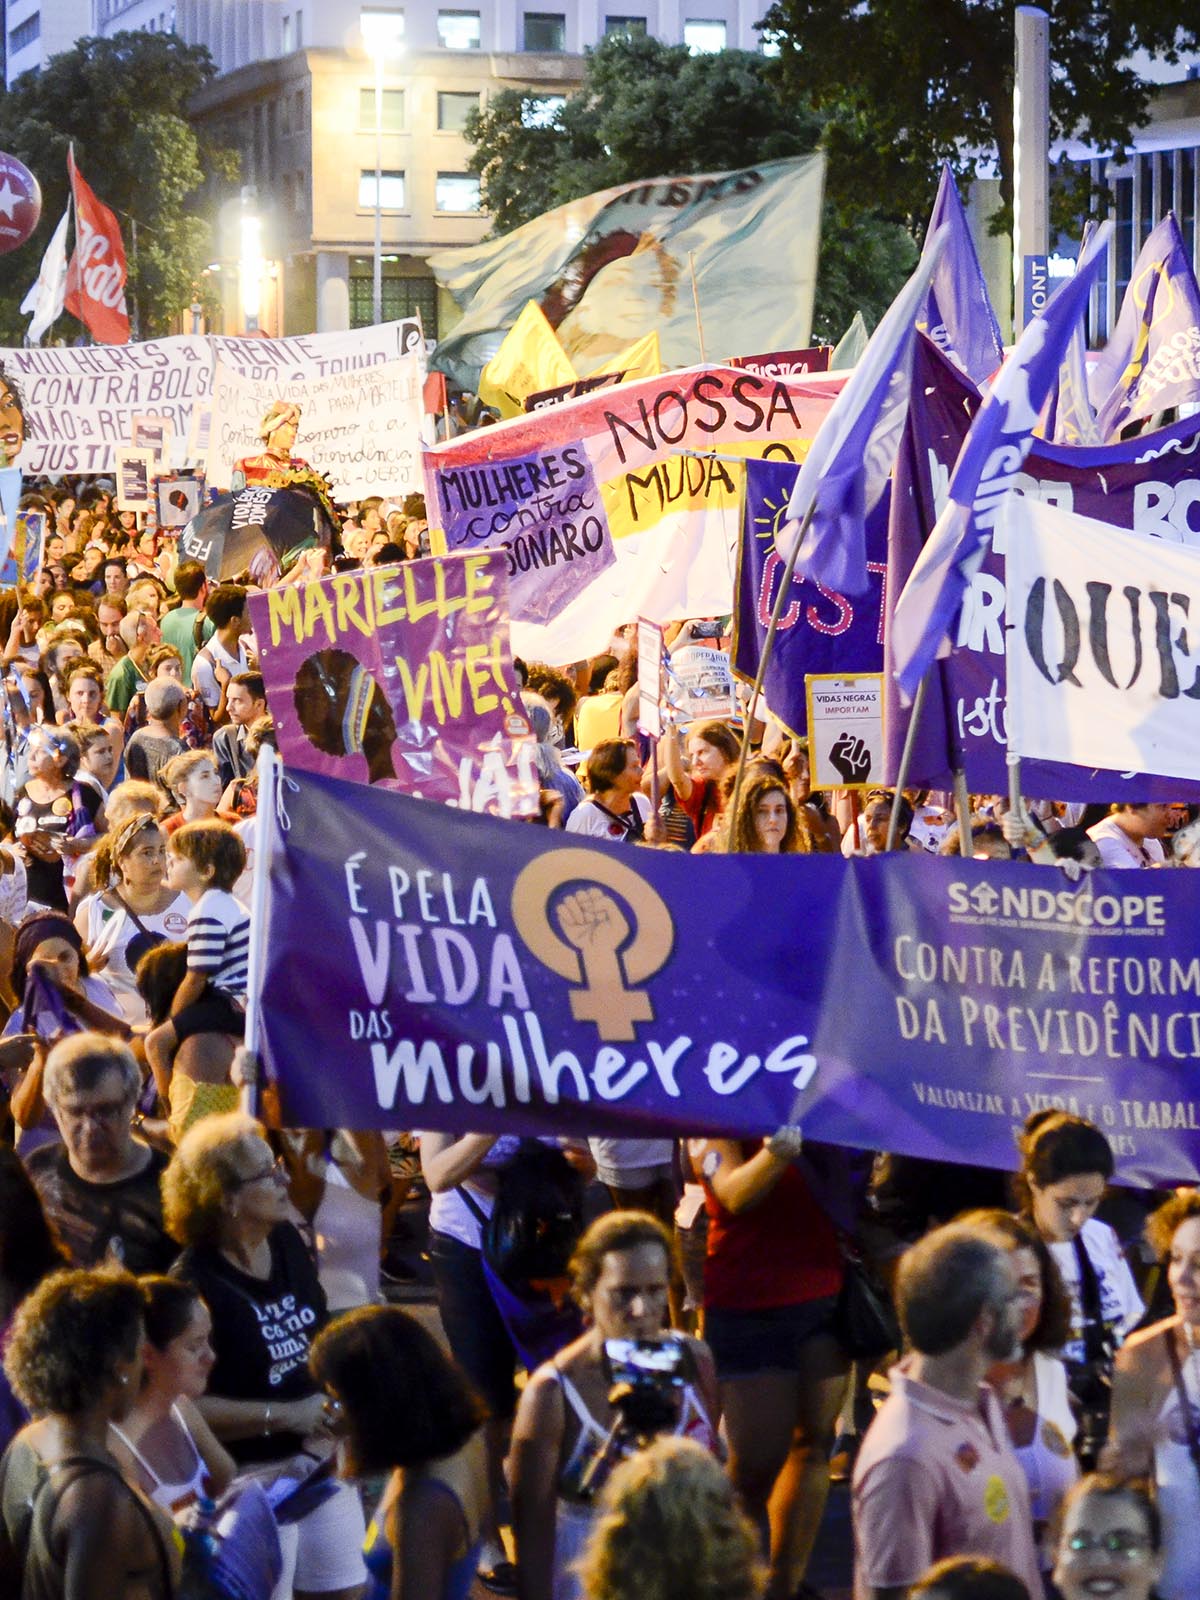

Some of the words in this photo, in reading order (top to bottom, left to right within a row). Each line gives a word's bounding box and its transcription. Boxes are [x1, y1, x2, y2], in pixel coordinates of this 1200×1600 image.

[213, 336, 323, 366] FRENTE
[31, 372, 139, 406] CONTRA
[28, 405, 77, 441] NÃO
[604, 375, 802, 464] NOSSA
[29, 444, 117, 473] JUSTI
[440, 448, 586, 513] MULHERES
[626, 450, 735, 522] MUDA
[456, 494, 594, 545] contra
[267, 555, 495, 648] MARIELLE
[395, 637, 516, 726] VIVE!
[816, 694, 842, 704] VIDAS
[843, 693, 877, 703] NEGRAS
[825, 705, 870, 715] IMPORTAM
[345, 851, 369, 915] É
[390, 866, 497, 928] PELA
[349, 917, 531, 1010] VIDA
[1037, 950, 1057, 993] A
[350, 1008, 393, 1041] DAS
[896, 996, 947, 1045] DA
[372, 1010, 820, 1111] mulheres
